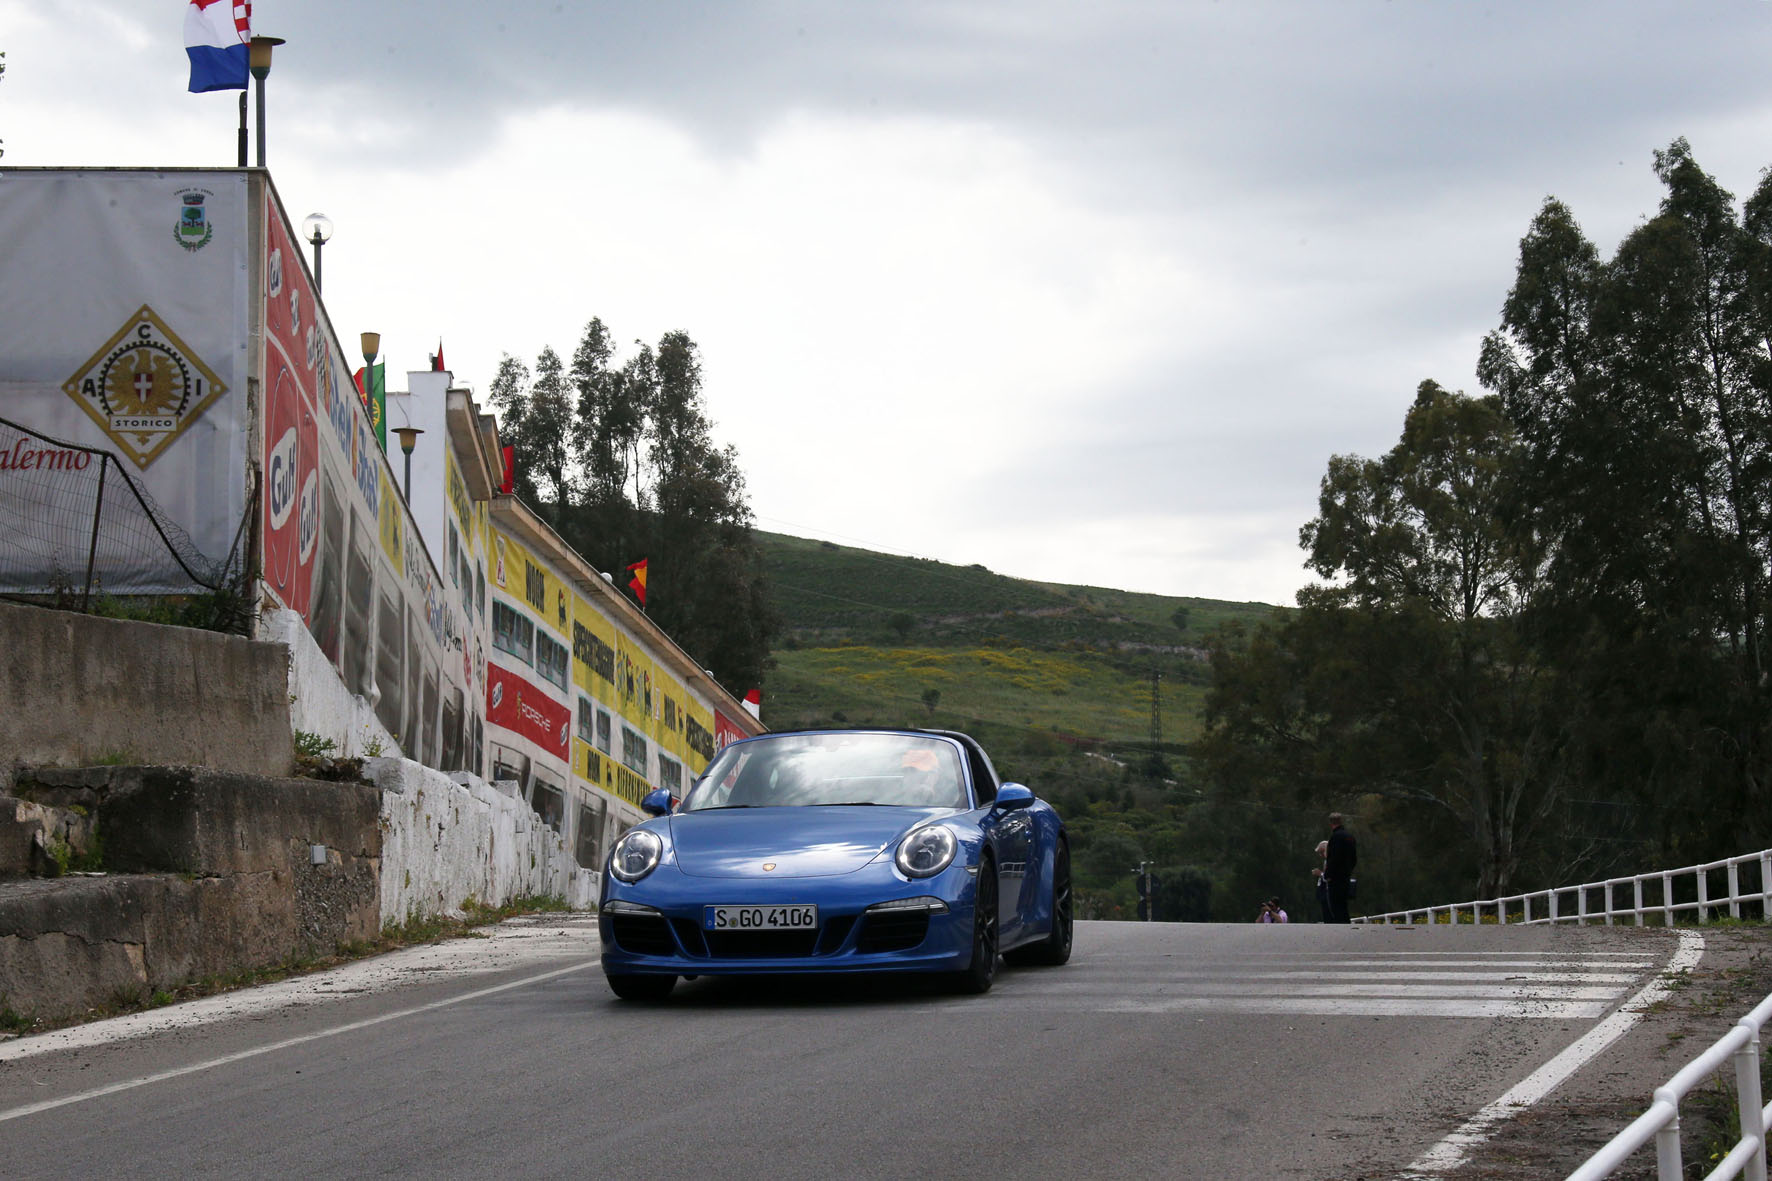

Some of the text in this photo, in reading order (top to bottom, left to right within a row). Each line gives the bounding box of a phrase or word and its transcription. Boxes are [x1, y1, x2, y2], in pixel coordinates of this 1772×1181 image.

[138, 324, 151, 339] C
[271, 440, 296, 518] Gulf
[300, 482, 317, 555] Gulf
[521, 702, 552, 732] PORSCHE
[716, 908, 814, 928] S GO 4106
